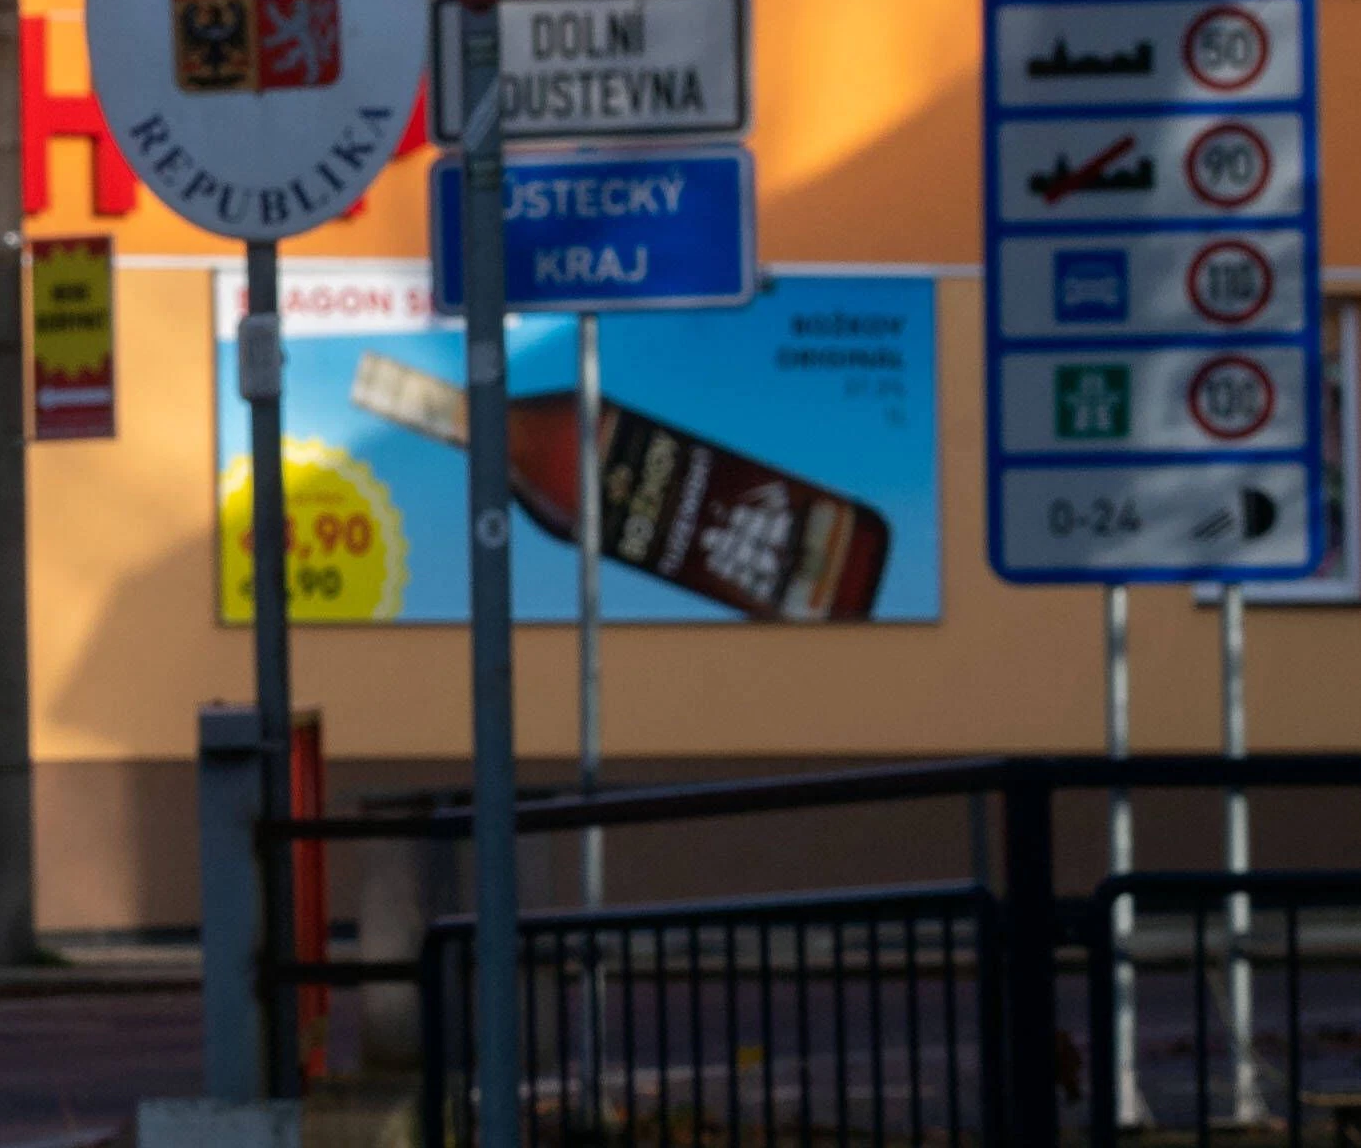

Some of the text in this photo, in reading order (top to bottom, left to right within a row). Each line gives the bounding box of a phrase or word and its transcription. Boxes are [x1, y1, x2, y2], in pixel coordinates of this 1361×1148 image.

[532, 0, 647, 60] DOLNÍ
[1200, 25, 1254, 70] 50
[498, 67, 707, 120] OUSTEVNA
[129, 104, 393, 227] REPUBLIKA
[1202, 142, 1255, 186] 90
[534, 246, 649, 284] KRAJ
[1048, 497, 1143, 539] 0-24
